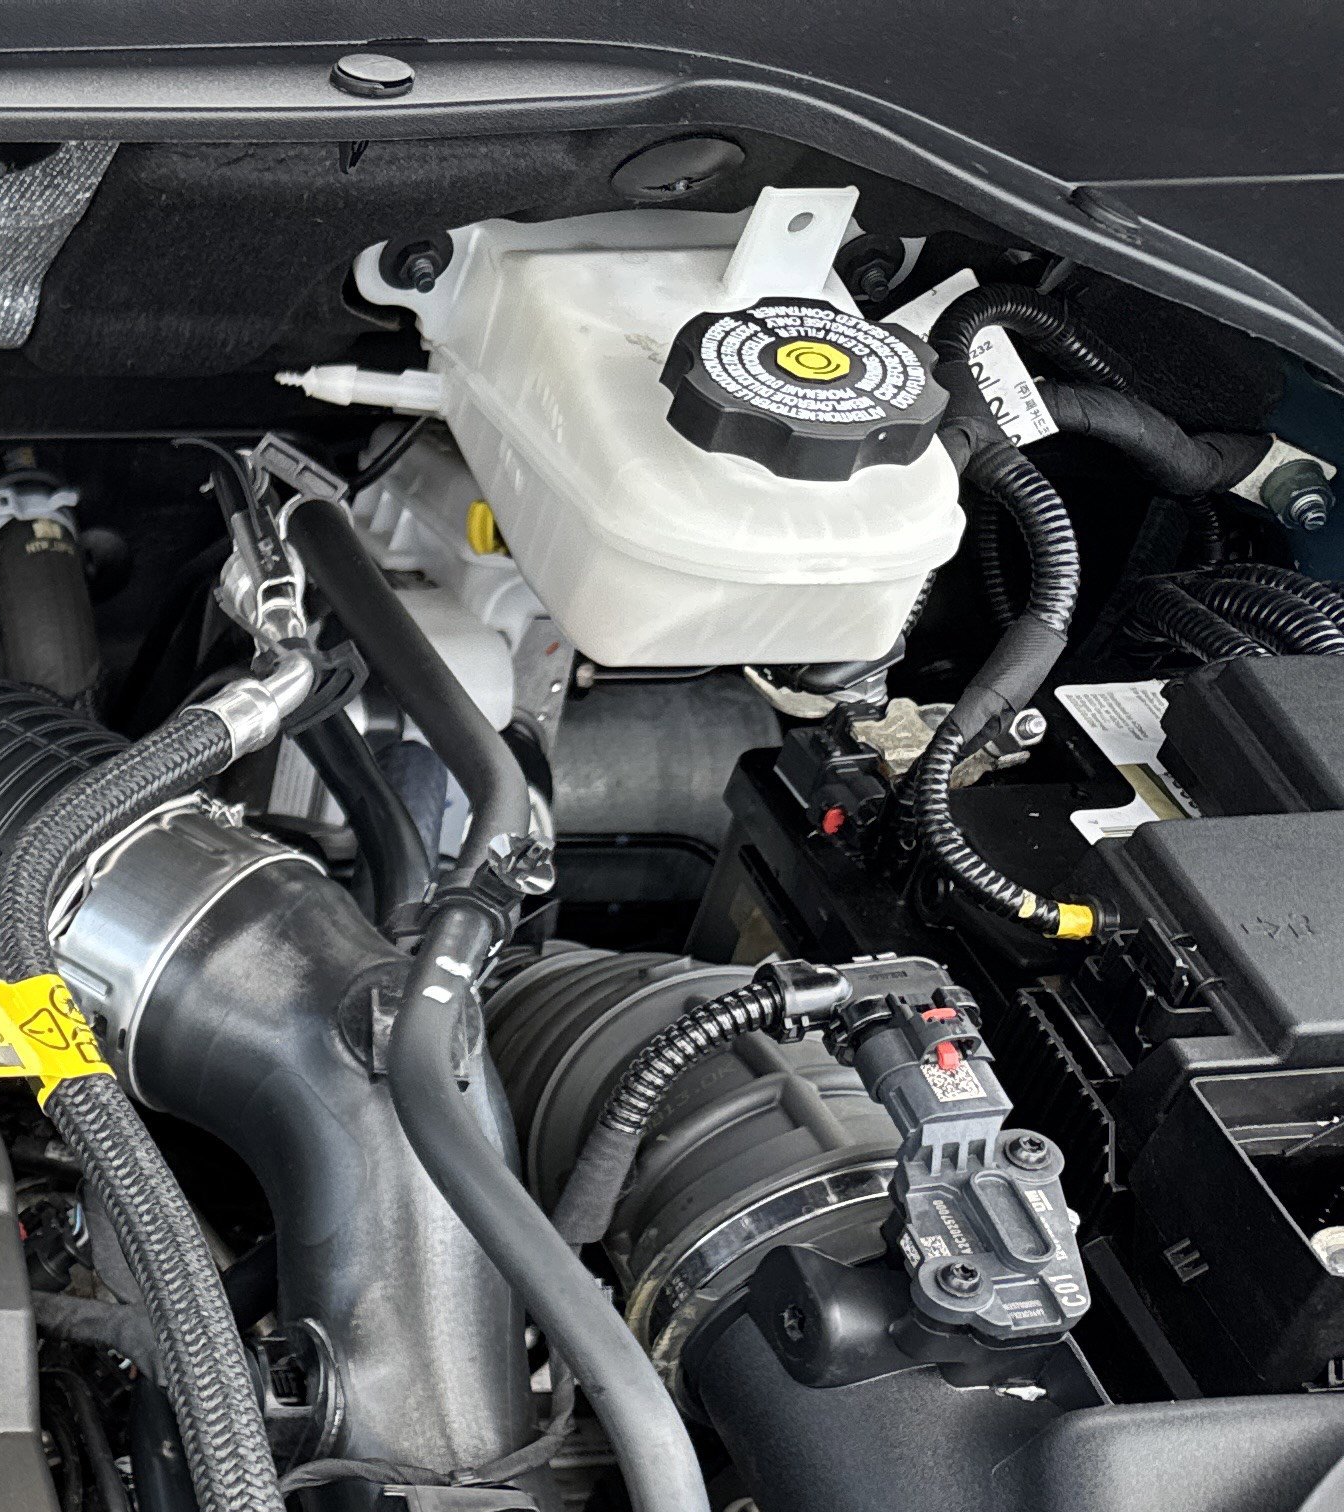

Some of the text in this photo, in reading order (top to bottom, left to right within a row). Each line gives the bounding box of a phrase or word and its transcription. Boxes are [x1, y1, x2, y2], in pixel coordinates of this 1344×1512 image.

[762, 317, 800, 328] ONLY
[775, 328, 825, 339] FILLER
[805, 318, 831, 330] USE
[837, 313, 892, 339] SEALED
[827, 333, 871, 356] CLEAN
[889, 343, 921, 365] FROM
[722, 355, 740, 363] DE
[702, 360, 743, 392] BOUCHON
[725, 365, 761, 389] LIQUIDE
[881, 357, 903, 386] BEFORE
[906, 368, 924, 390] FLUID
[734, 389, 755, 401] LE
[753, 386, 775, 398] DU
[770, 392, 797, 407] QUE
[872, 383, 900, 401] CAP
[749, 396, 814, 421] NETTOYER
[1048, 1274, 1087, 1307] C01
